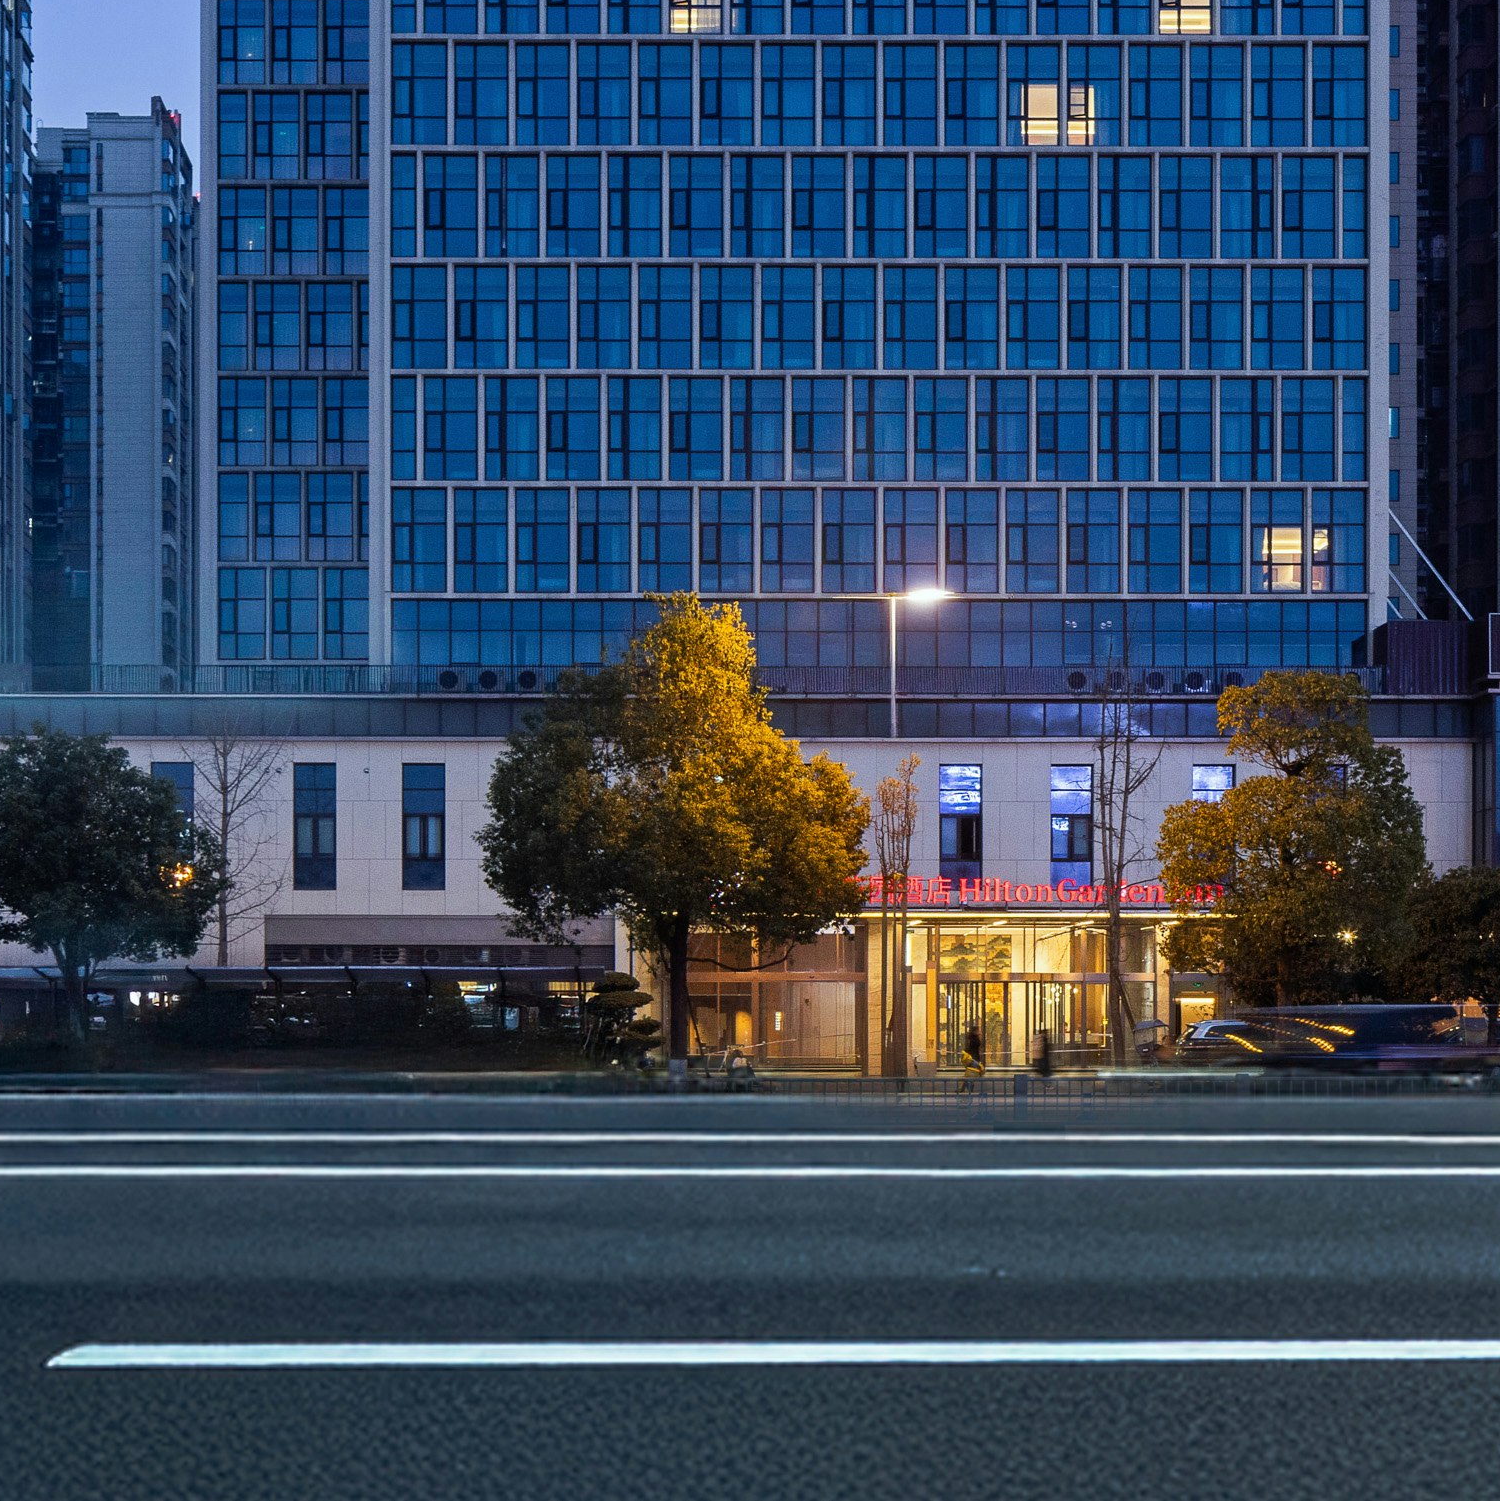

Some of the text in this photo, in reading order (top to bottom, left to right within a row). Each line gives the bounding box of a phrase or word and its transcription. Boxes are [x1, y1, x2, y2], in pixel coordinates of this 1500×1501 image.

[844, 874, 952, 906] 园酒店
[958, 877, 1053, 904] Hilton
